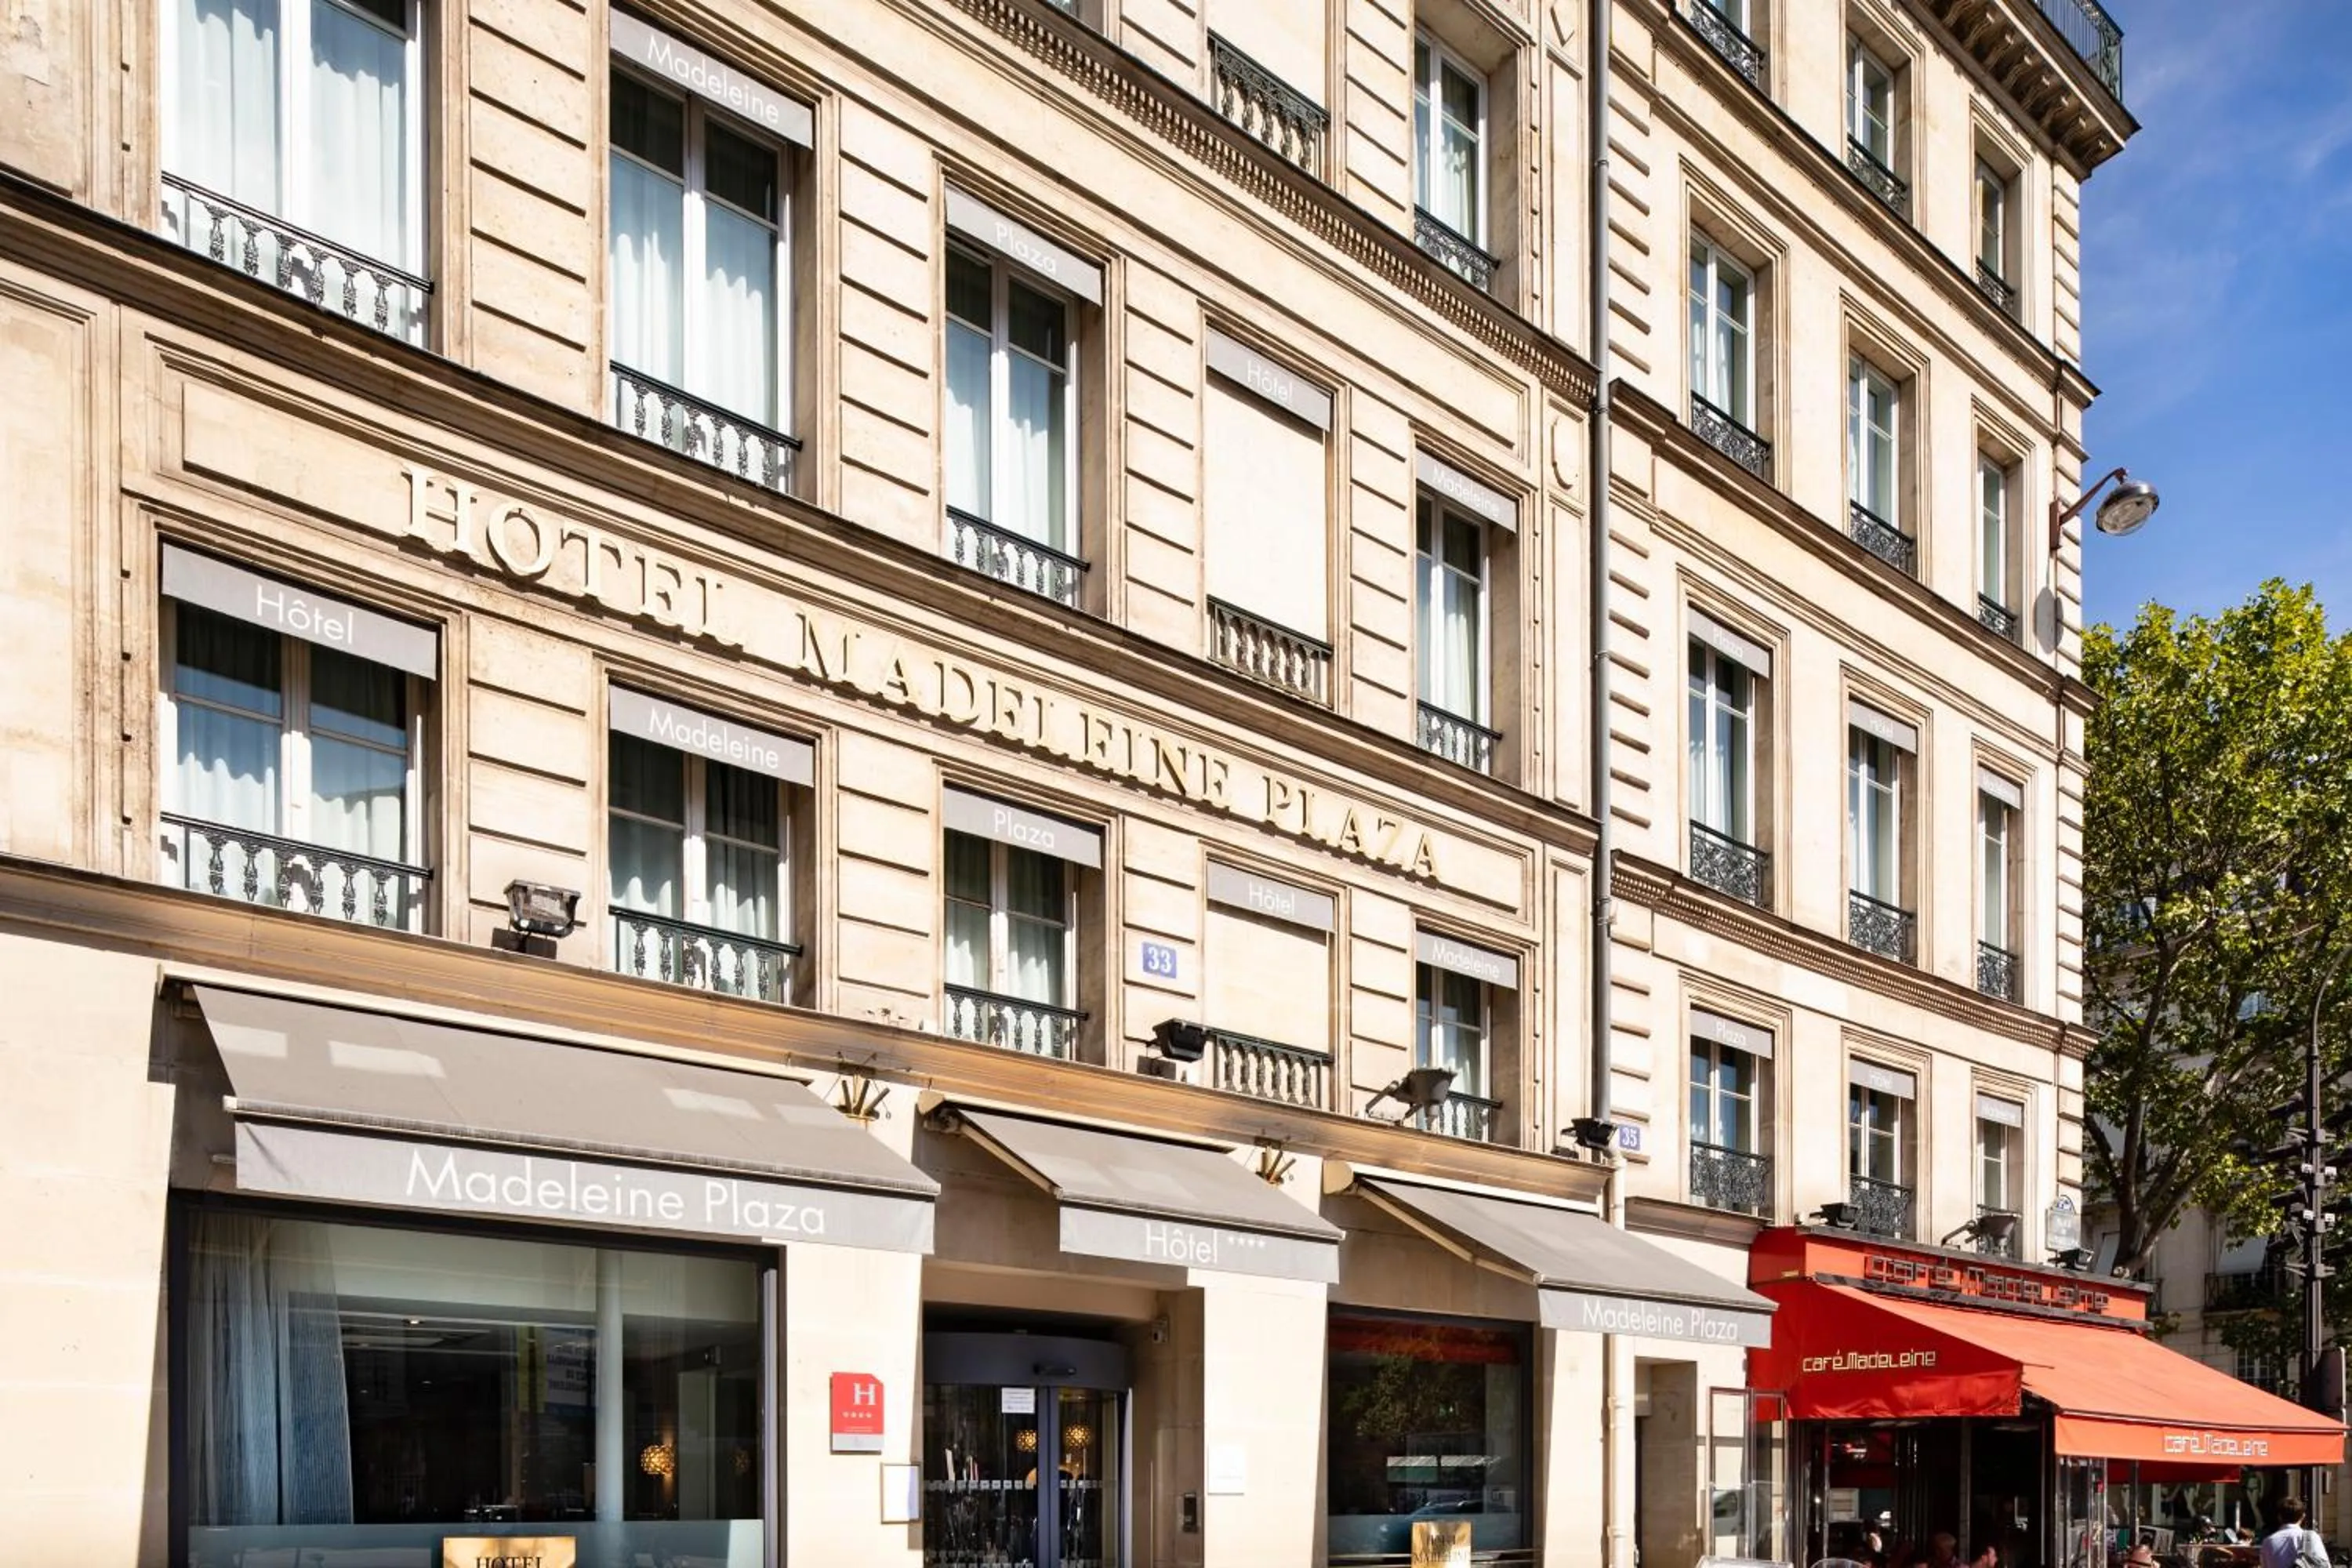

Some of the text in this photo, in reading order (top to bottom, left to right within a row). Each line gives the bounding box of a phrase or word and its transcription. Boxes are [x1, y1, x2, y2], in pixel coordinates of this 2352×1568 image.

[647, 34, 779, 124] Madeleine
[994, 221, 1058, 274] Plaza
[1247, 359, 1294, 405] Hôtel
[1432, 466, 1500, 518] Madeleine
[256, 583, 354, 645] Hôtel
[400, 461, 1440, 883] HOTEL MADELEINE PLAZA
[648, 707, 779, 769] Madeleine
[993, 808, 1055, 850] Plaza
[1247, 882, 1296, 917] Hôtel
[1147, 946, 1174, 975] 33
[1431, 941, 1501, 978] Madeleine
[1621, 1127, 1638, 1147] 35
[405, 1147, 826, 1235] Madeleine Plaza
[1145, 1221, 1218, 1265] Hôtel
[1582, 1298, 1739, 1341] Madeleine Plaza
[853, 1382, 877, 1406] H
[474, 1555, 543, 1568] HOTEL
